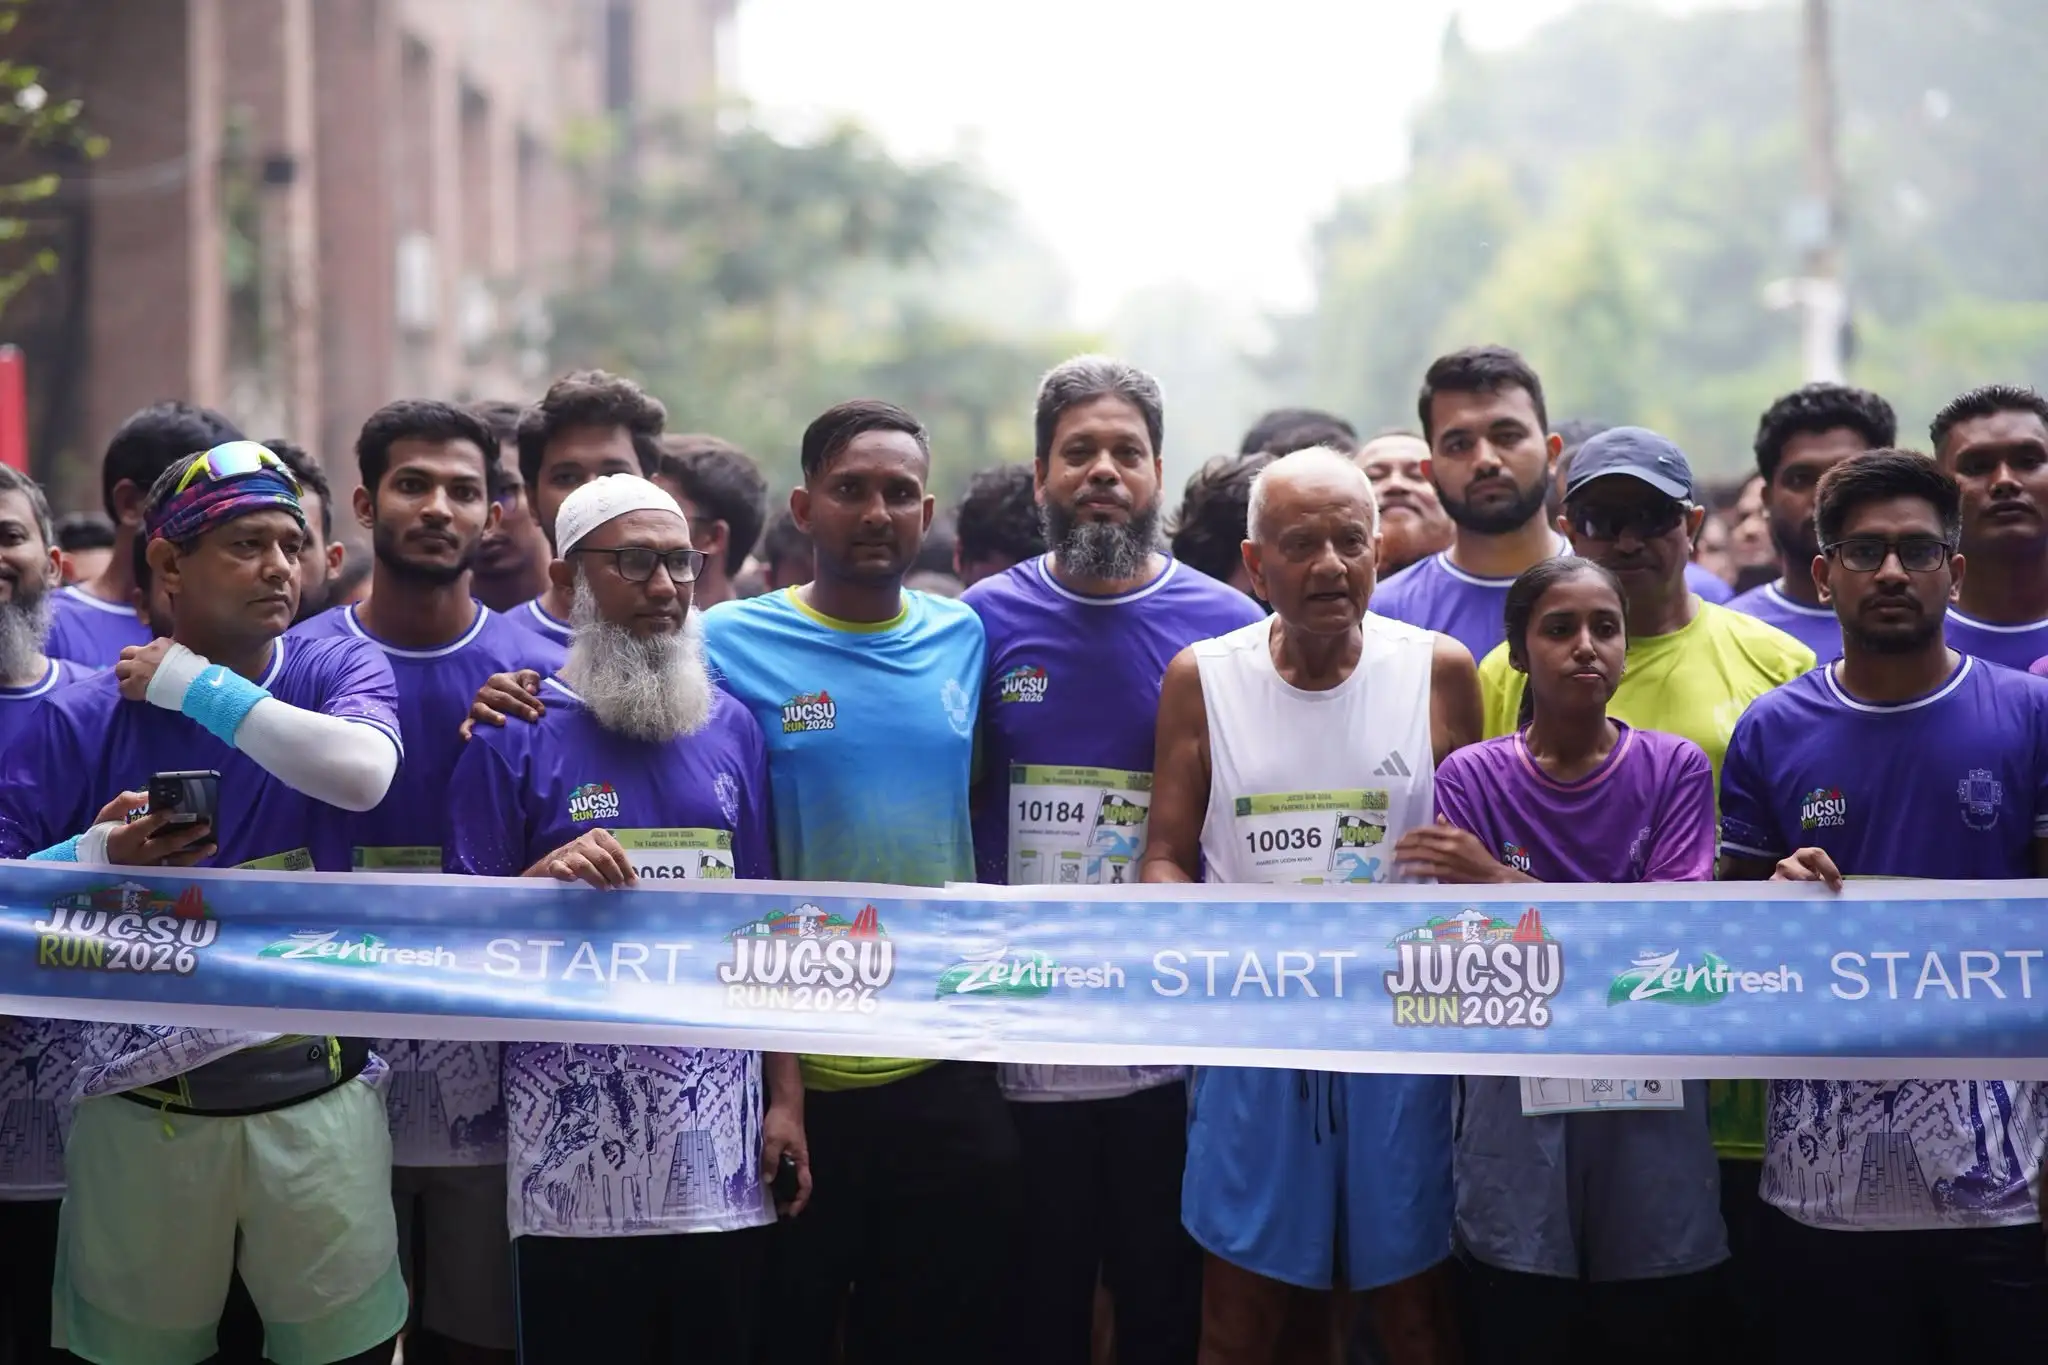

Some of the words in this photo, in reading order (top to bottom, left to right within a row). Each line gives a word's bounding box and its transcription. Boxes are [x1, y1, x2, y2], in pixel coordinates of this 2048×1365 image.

[1001, 677, 1048, 694] JUCSU
[1019, 692, 1043, 702] 2026
[782, 702, 835, 723] JUCSU
[784, 721, 804, 732] RUN
[806, 719, 834, 730] 2026
[568, 792, 619, 813] JUCSU
[572, 810, 593, 822] RUN
[593, 808, 619, 819] 2026
[1018, 800, 1085, 822] 10184
[1801, 798, 1846, 821] JUCSU
[1818, 815, 1844, 827] 2026
[1246, 827, 1322, 853] 10036
[34, 907, 218, 948] JUCSU
[40, 934, 104, 968] RUN
[106, 939, 196, 973] 2026
[281, 929, 456, 968] Zenfresh
[483, 938, 693, 985] START
[720, 938, 892, 988] JUCSU
[956, 946, 1125, 993] Zenfresh
[1151, 949, 1358, 998] START
[1387, 943, 1560, 996] JUCSU
[1629, 948, 1804, 1001] Zenfresh
[1830, 951, 2044, 1000] START
[728, 984, 790, 1009] RUN
[792, 986, 878, 1014] 2026
[1396, 995, 1459, 1024] RUN
[1462, 995, 1549, 1026] 2026
